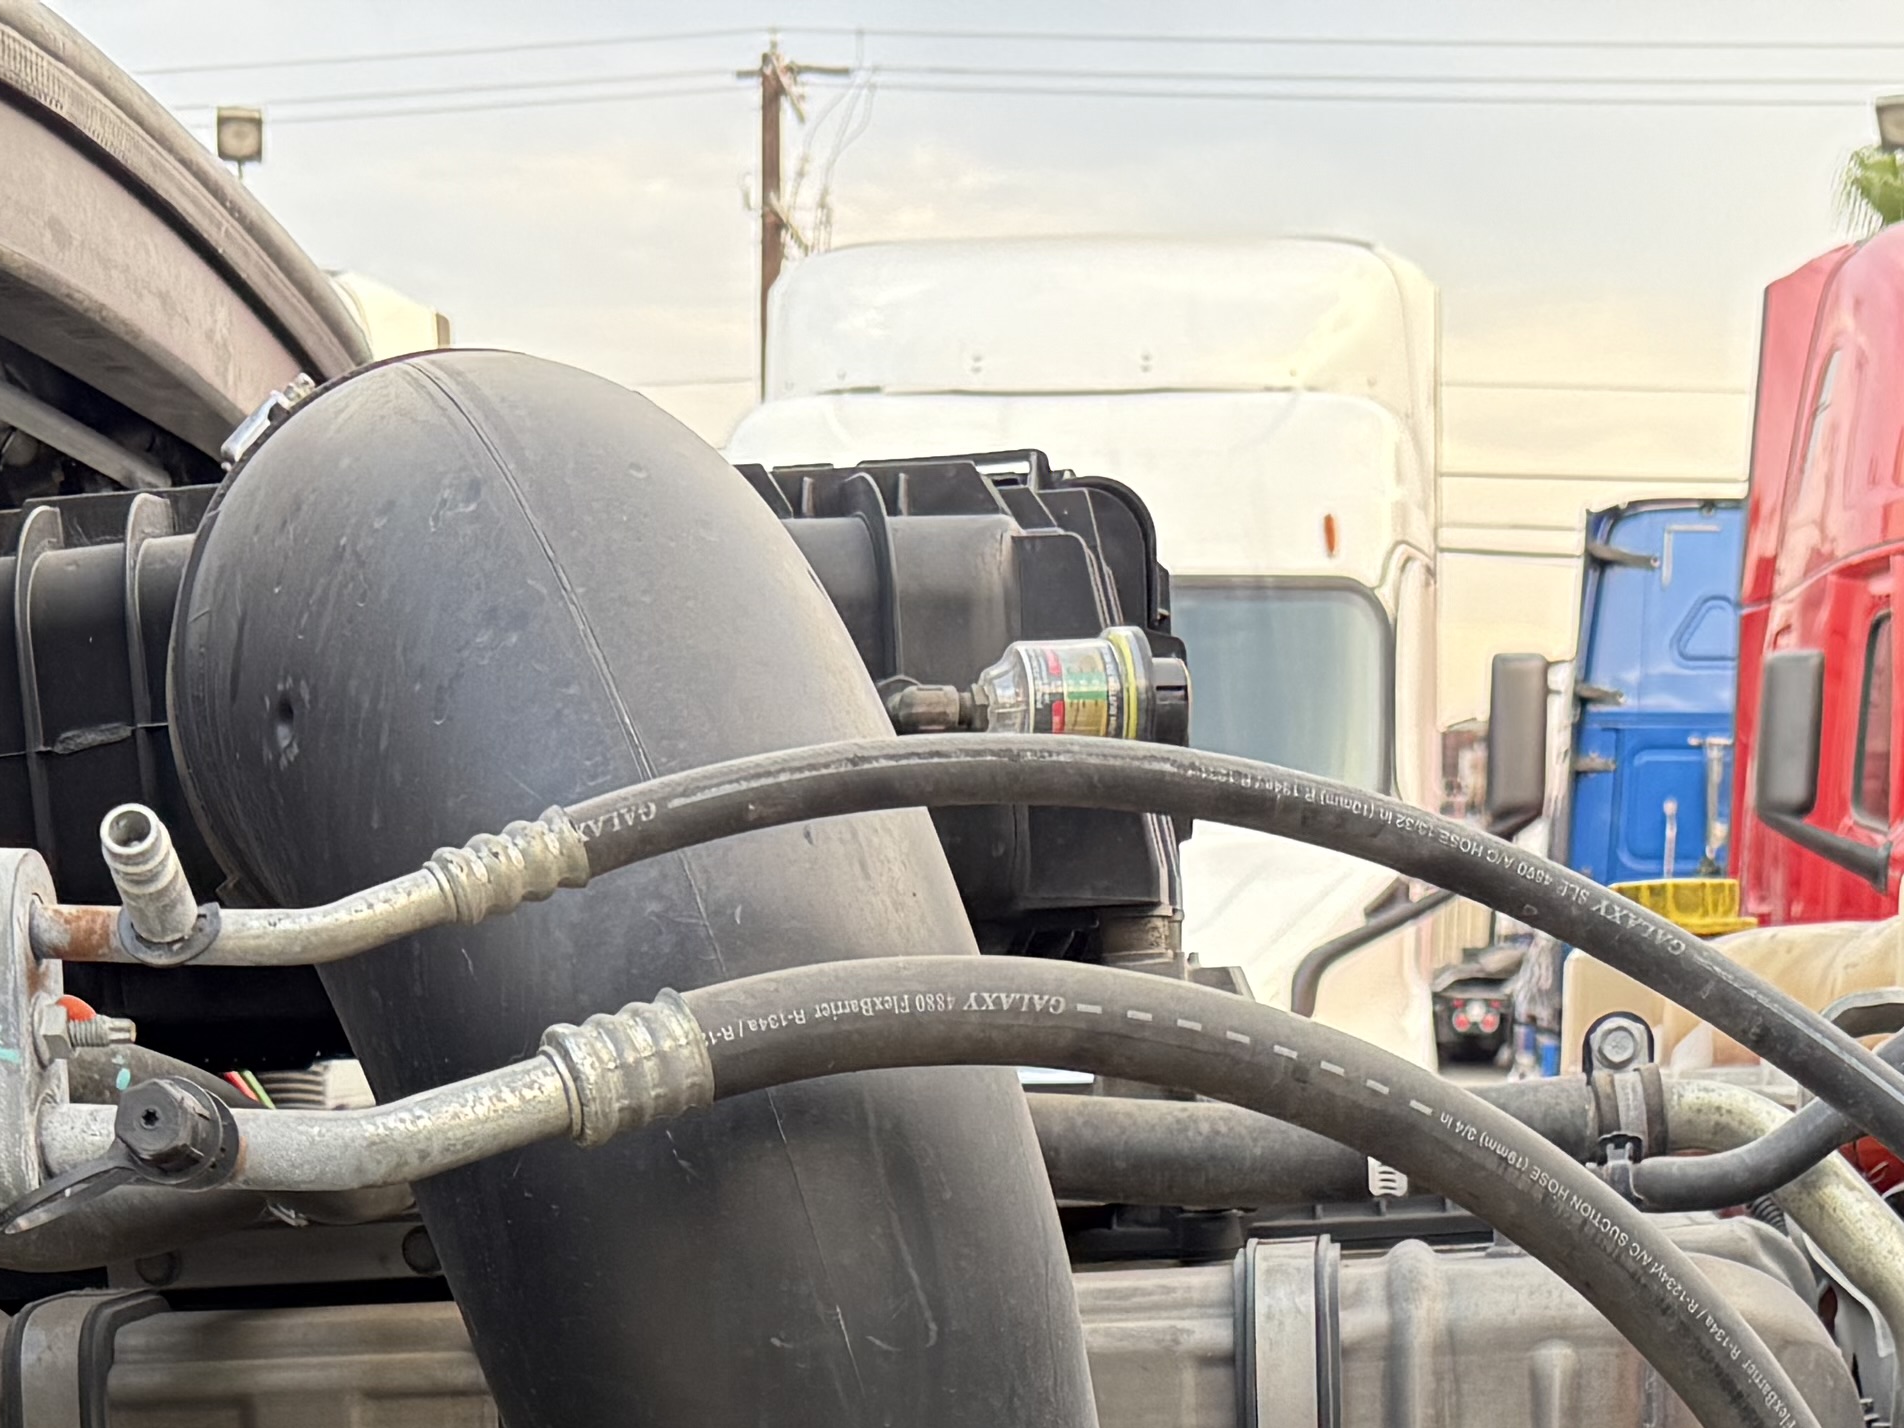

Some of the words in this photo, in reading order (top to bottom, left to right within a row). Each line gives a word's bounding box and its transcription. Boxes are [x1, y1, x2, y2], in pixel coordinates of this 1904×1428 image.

[1432, 827, 1484, 858] HOSE
[1589, 894, 1687, 958] GALAXY
[813, 994, 910, 1020] FlexBarrier
[915, 992, 956, 1012] 4880
[963, 992, 1065, 1013] GALAXY
[1477, 1128, 1530, 1173] (19mm)
[1527, 1163, 1570, 1202] HOSE
[1566, 1193, 1631, 1248] SUCTION
